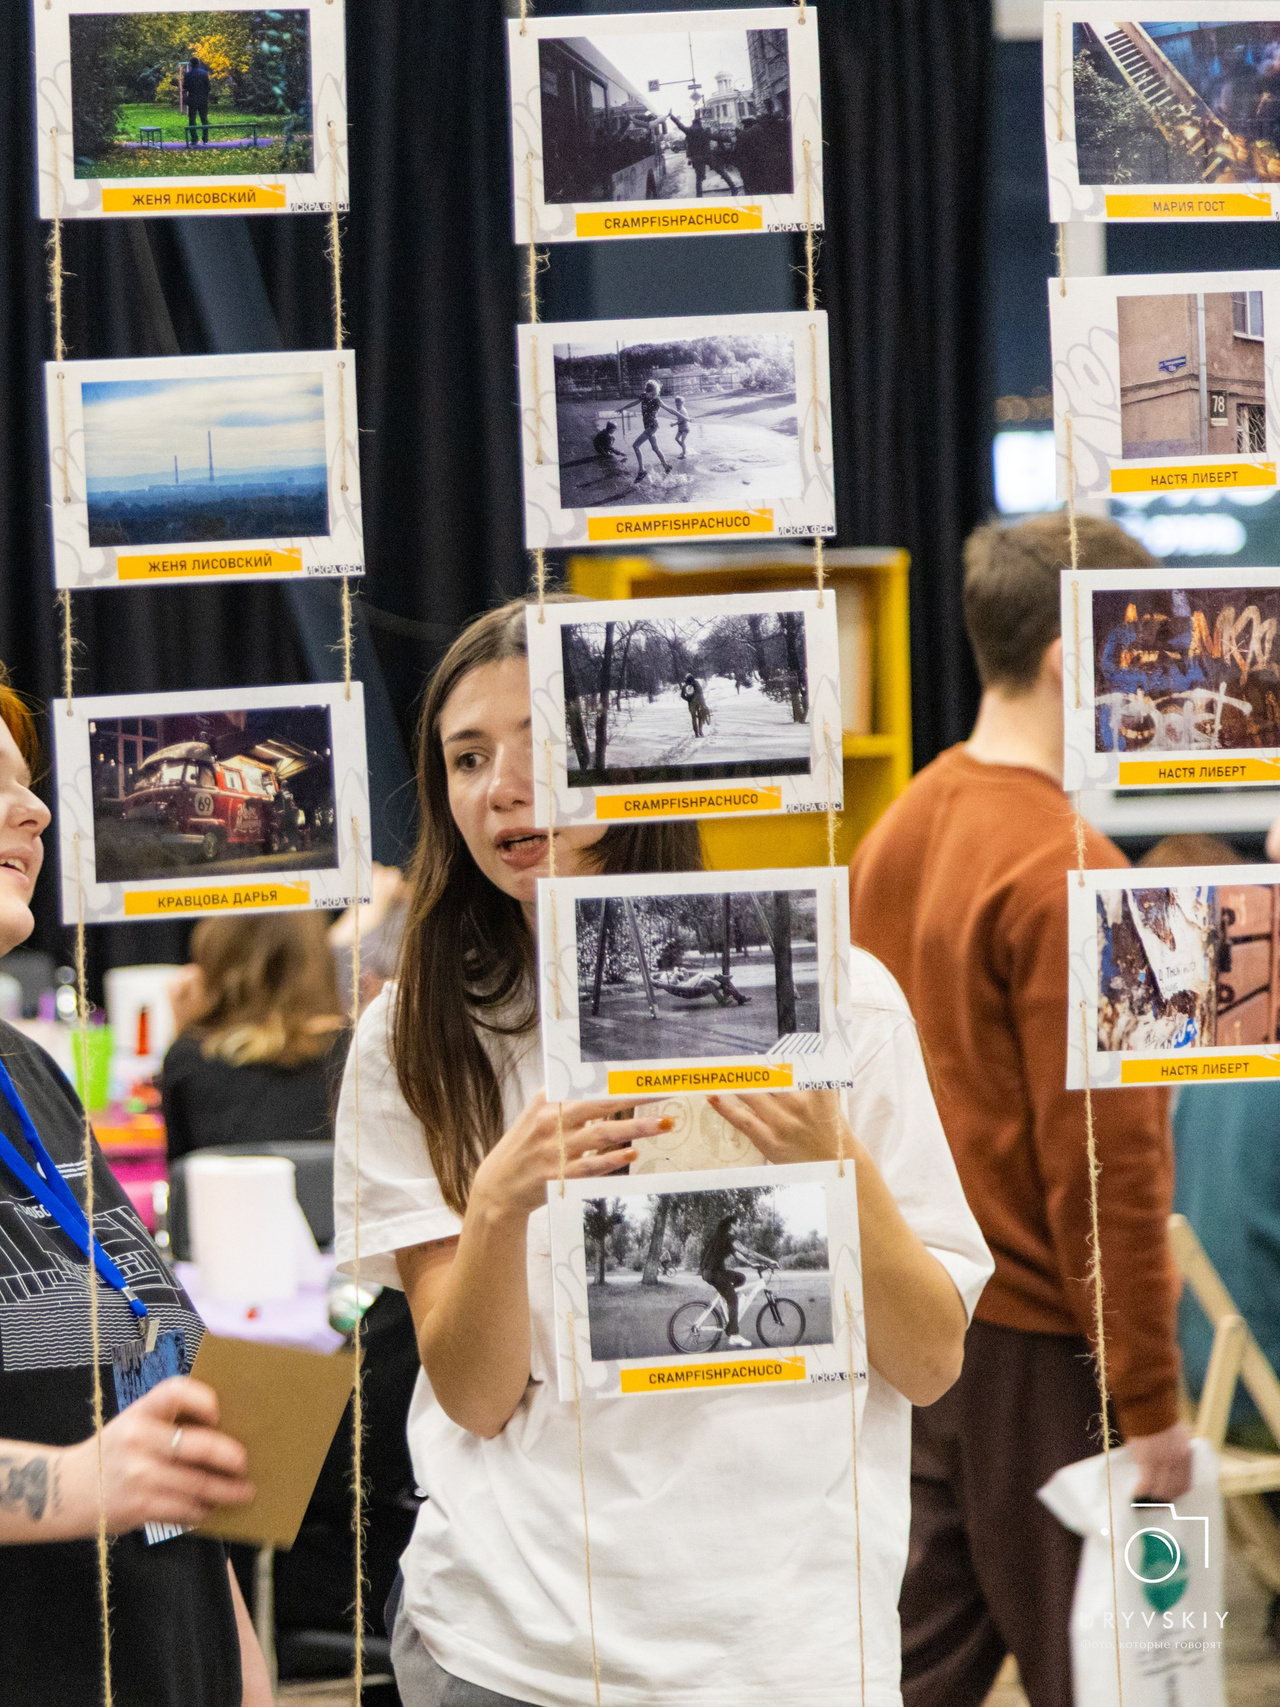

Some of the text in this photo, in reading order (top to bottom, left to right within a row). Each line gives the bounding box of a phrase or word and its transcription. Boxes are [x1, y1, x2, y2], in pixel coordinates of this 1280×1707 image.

[132, 189, 256, 205] ЖЕНЯ ЛИСОВСКИЙ
[290, 202, 349, 211] ИСКРА ФСТ
[1153, 201, 1225, 211] МАРИЯ ГОСТ
[604, 213, 739, 228] CRAMPFISHPACHUCO
[766, 223, 798, 231] ИСКРА
[1212, 395, 1225, 413] 78
[1151, 471, 1239, 485] НАСТЯ ЛИБЕРТ
[616, 516, 751, 533] CRAMPFISHPACHUCO
[778, 526, 809, 535] ИСКРА
[148, 553, 272, 572] ЖЕНЯ ЛИСОВСКИЙ
[307, 566, 338, 574] ИСКРА
[1159, 765, 1246, 779] НАСТЯ ЛИБЕРТ
[198, 796, 211, 812] 69
[624, 793, 759, 811] CRAMPFISHPACHUCO
[786, 803, 817, 812] ИСКРА
[157, 890, 278, 908] КРАВЦОВА ДАРЬЯ
[314, 898, 345, 907] ИСКРА
[1161, 1062, 1250, 1077] НАСТЯ ЛИБЕРТ
[636, 1070, 770, 1087] CRAMPFISHPACHUCO
[798, 1081, 829, 1091] ИСКРА
[649, 1364, 783, 1384] CRAMPFISHPACHUCO
[810, 1373, 842, 1383] ИСКРА
